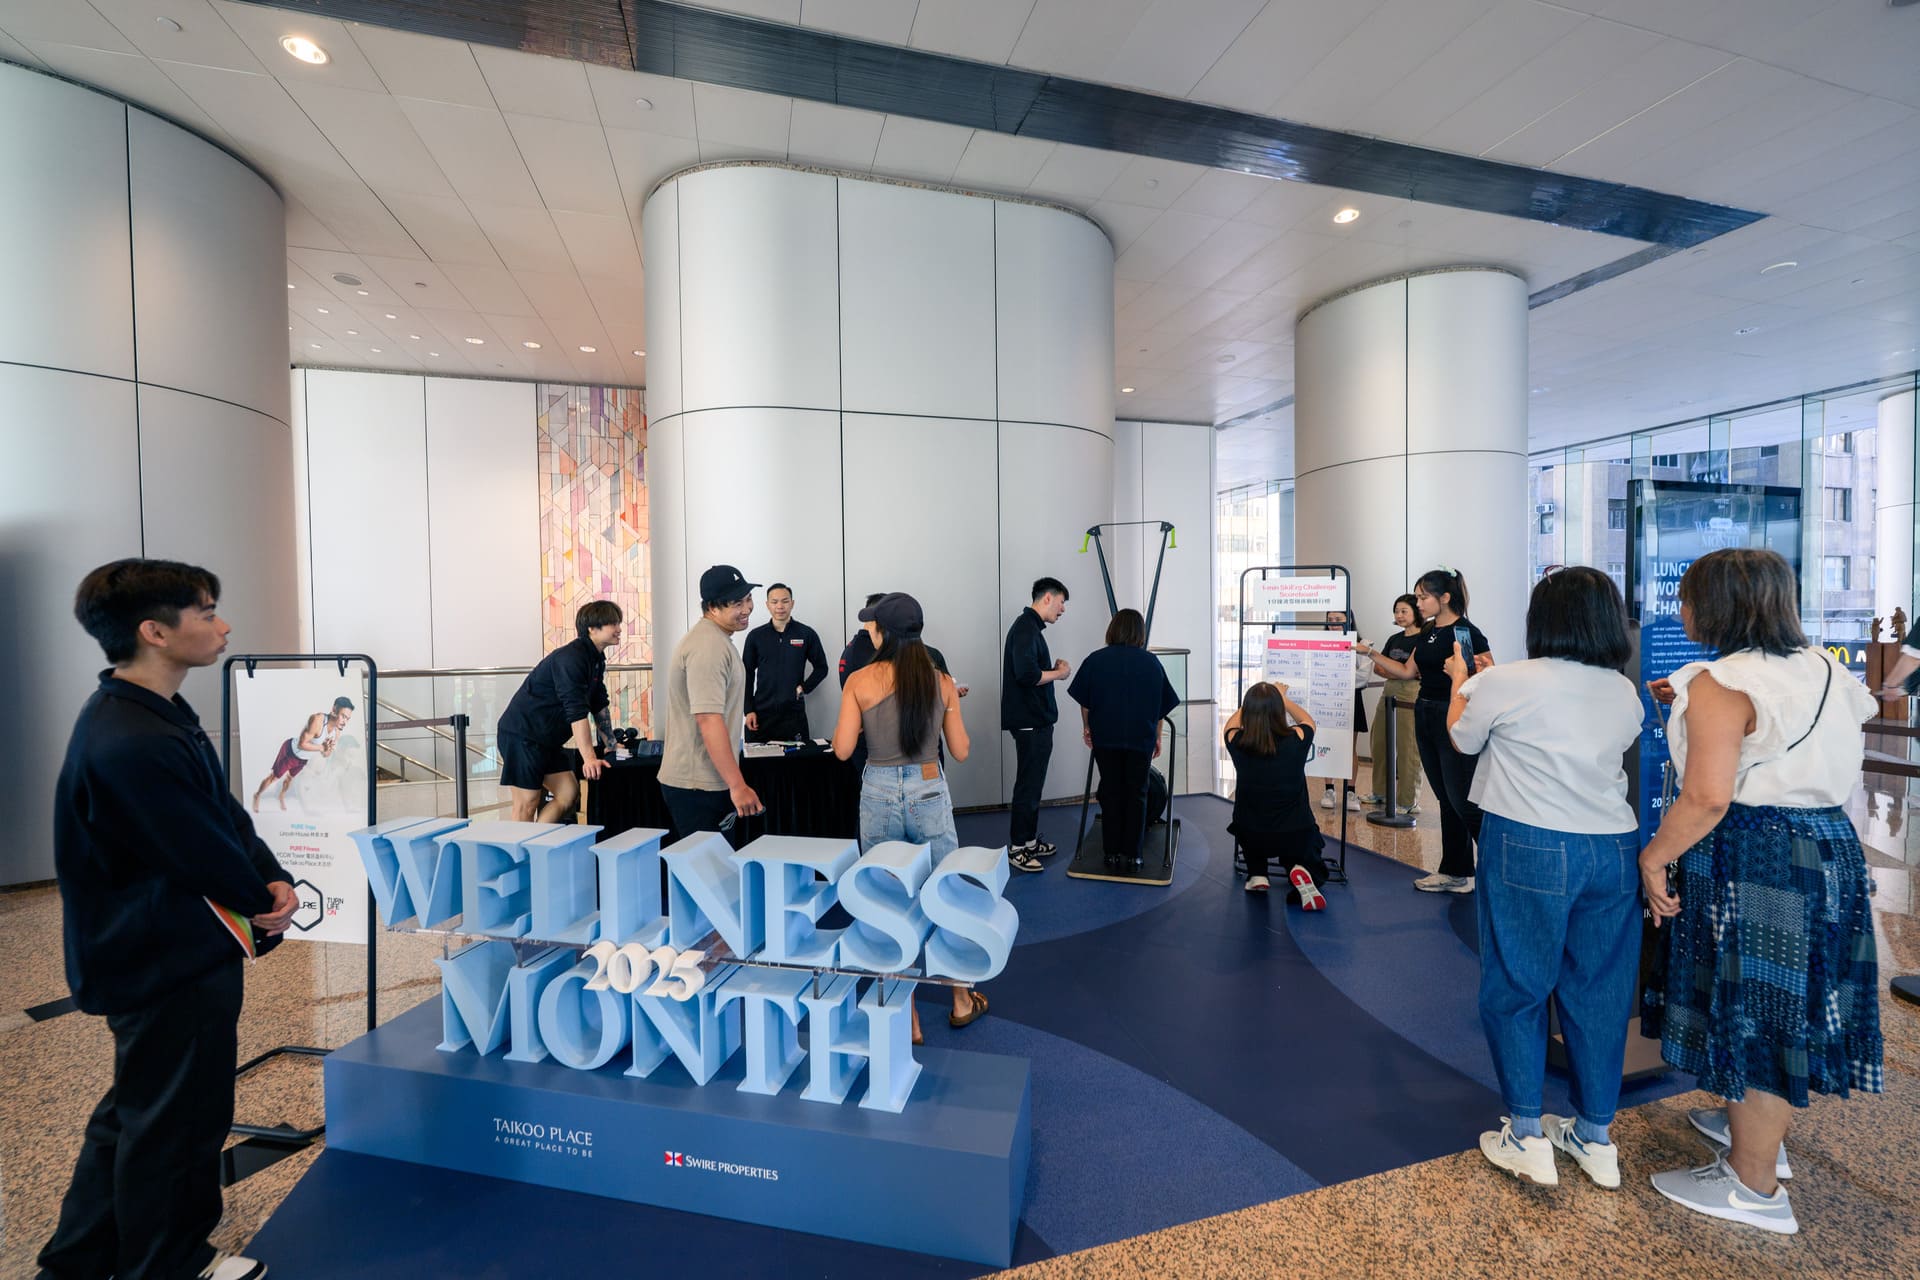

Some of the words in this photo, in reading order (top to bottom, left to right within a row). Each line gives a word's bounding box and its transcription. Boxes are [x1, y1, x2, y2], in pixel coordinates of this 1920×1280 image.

[1279, 590, 1319, 598] Scoreboard
[1303, 583, 1337, 592] Challenge
[327, 897, 344, 905] TURN
[346, 816, 1019, 982] WELLNESS
[582, 941, 705, 1001] 2025
[434, 940, 922, 1113] MONTH
[493, 1117, 545, 1138] TAIKOO
[549, 1126, 593, 1147] PLACE
[503, 1136, 531, 1148] GREAT
[535, 1141, 563, 1153] PLACE
[566, 1146, 578, 1156] TO
[581, 1149, 593, 1158] BE
[718, 1161, 779, 1181] PROPERTIES
